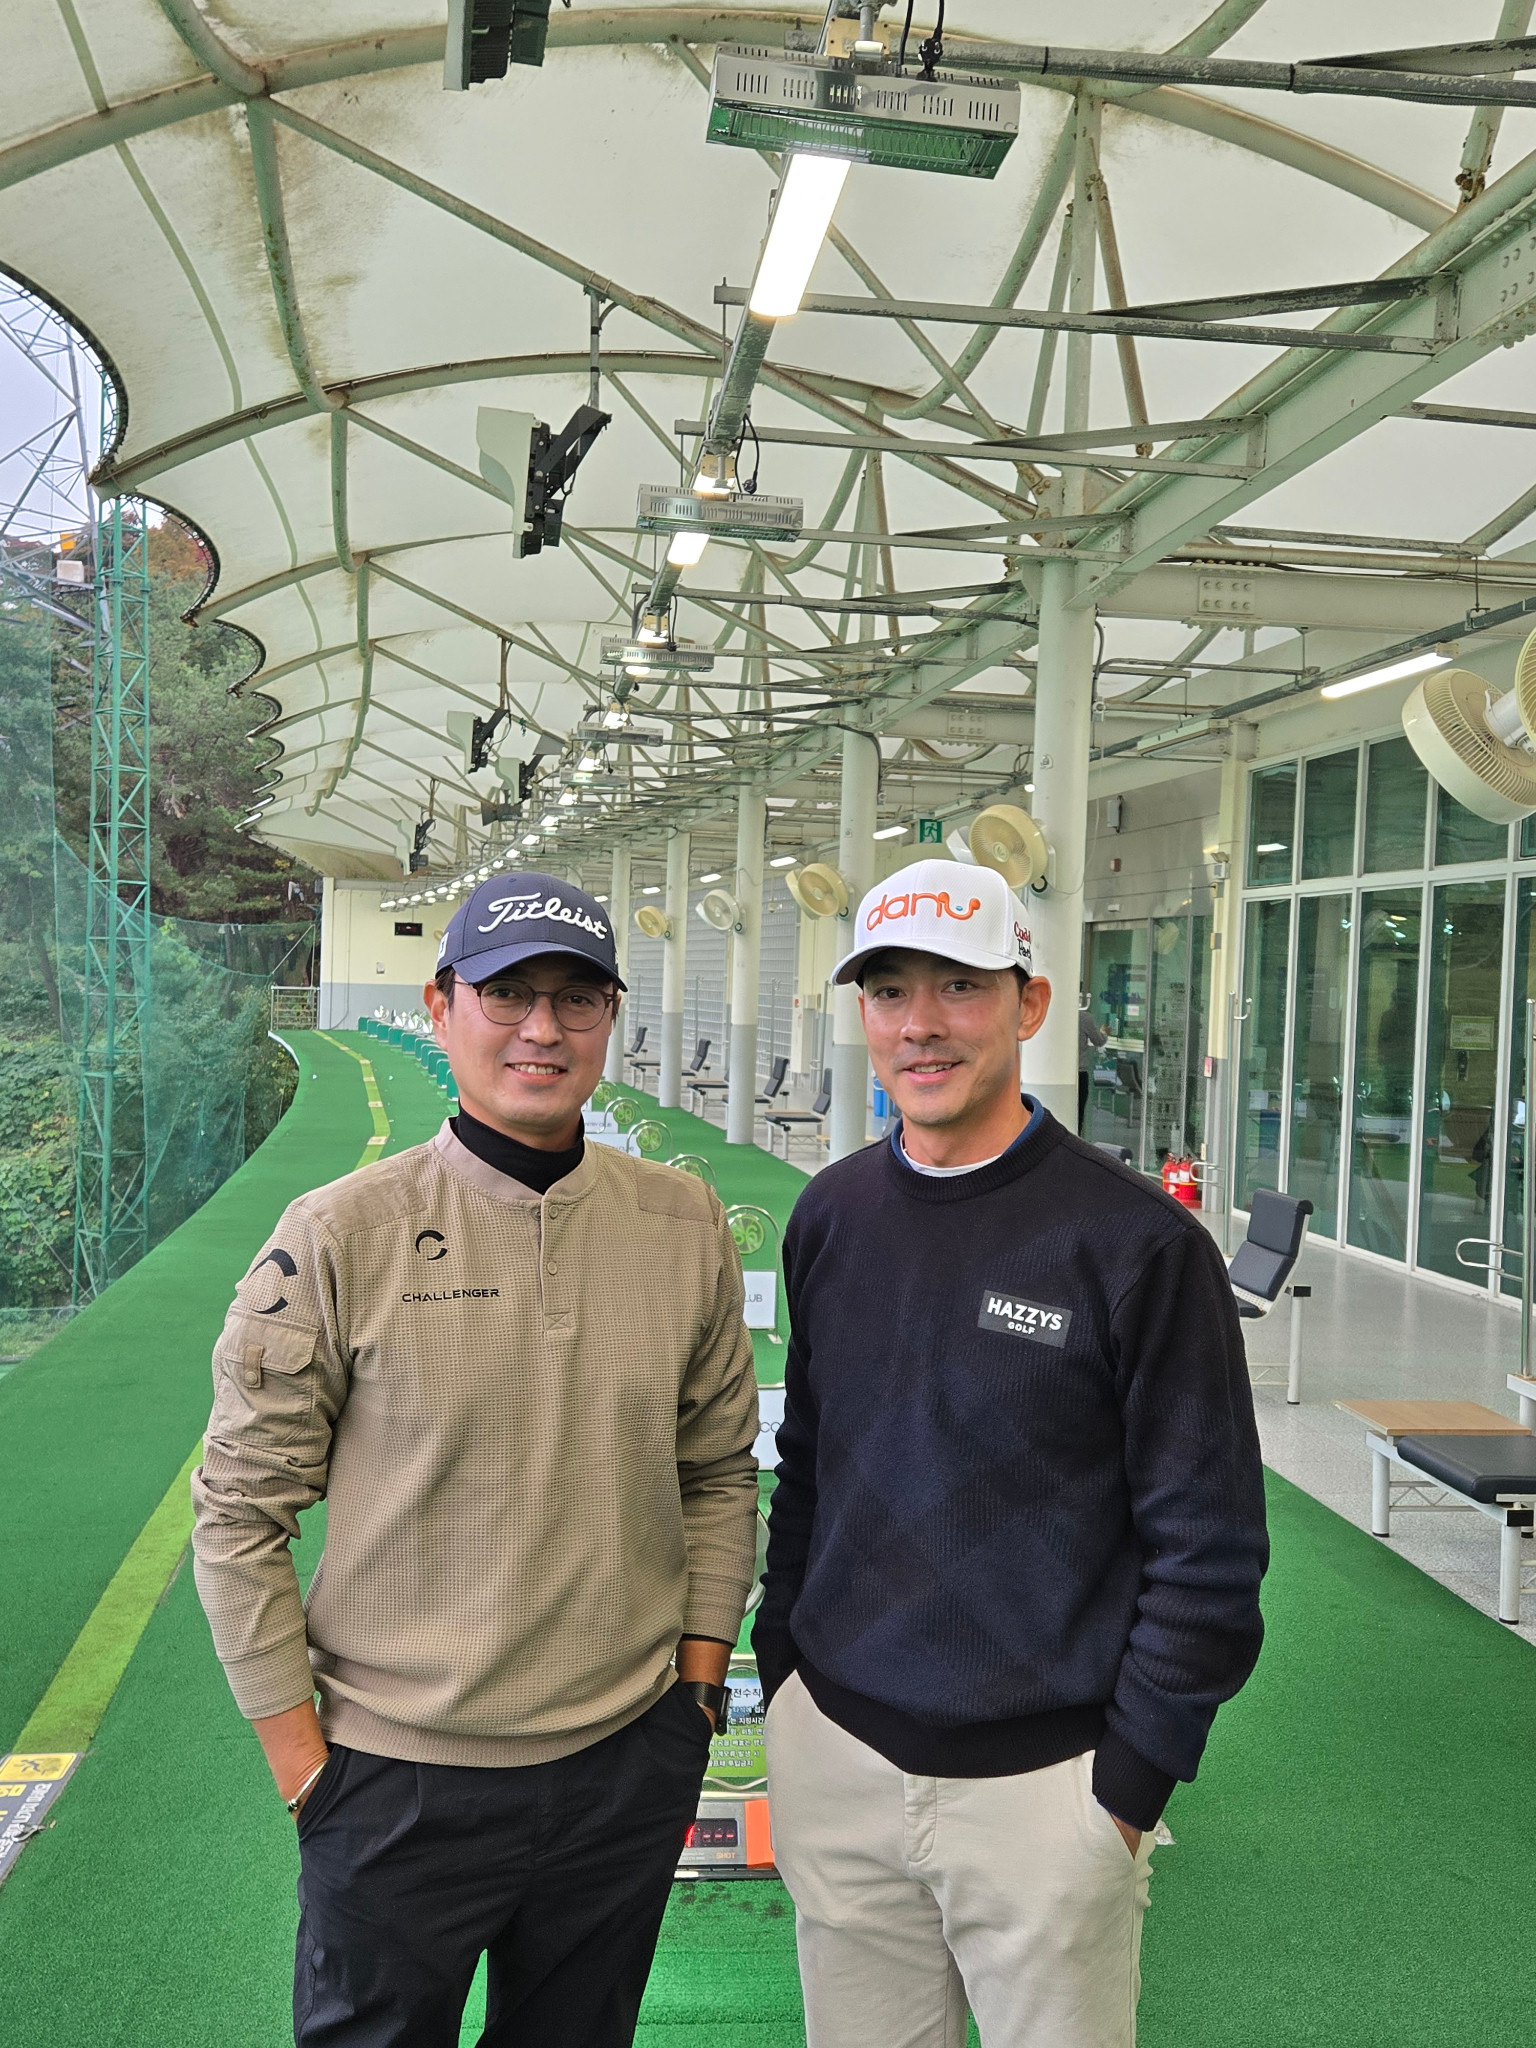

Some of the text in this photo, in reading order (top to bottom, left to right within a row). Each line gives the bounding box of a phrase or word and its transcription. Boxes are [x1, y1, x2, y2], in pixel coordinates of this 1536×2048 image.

[477, 892, 608, 940] Titleist
[401, 1288, 500, 1303] CHALLENGER
[987, 1297, 1063, 1331] HAZZYS
[1007, 1321, 1036, 1335] GOLF
